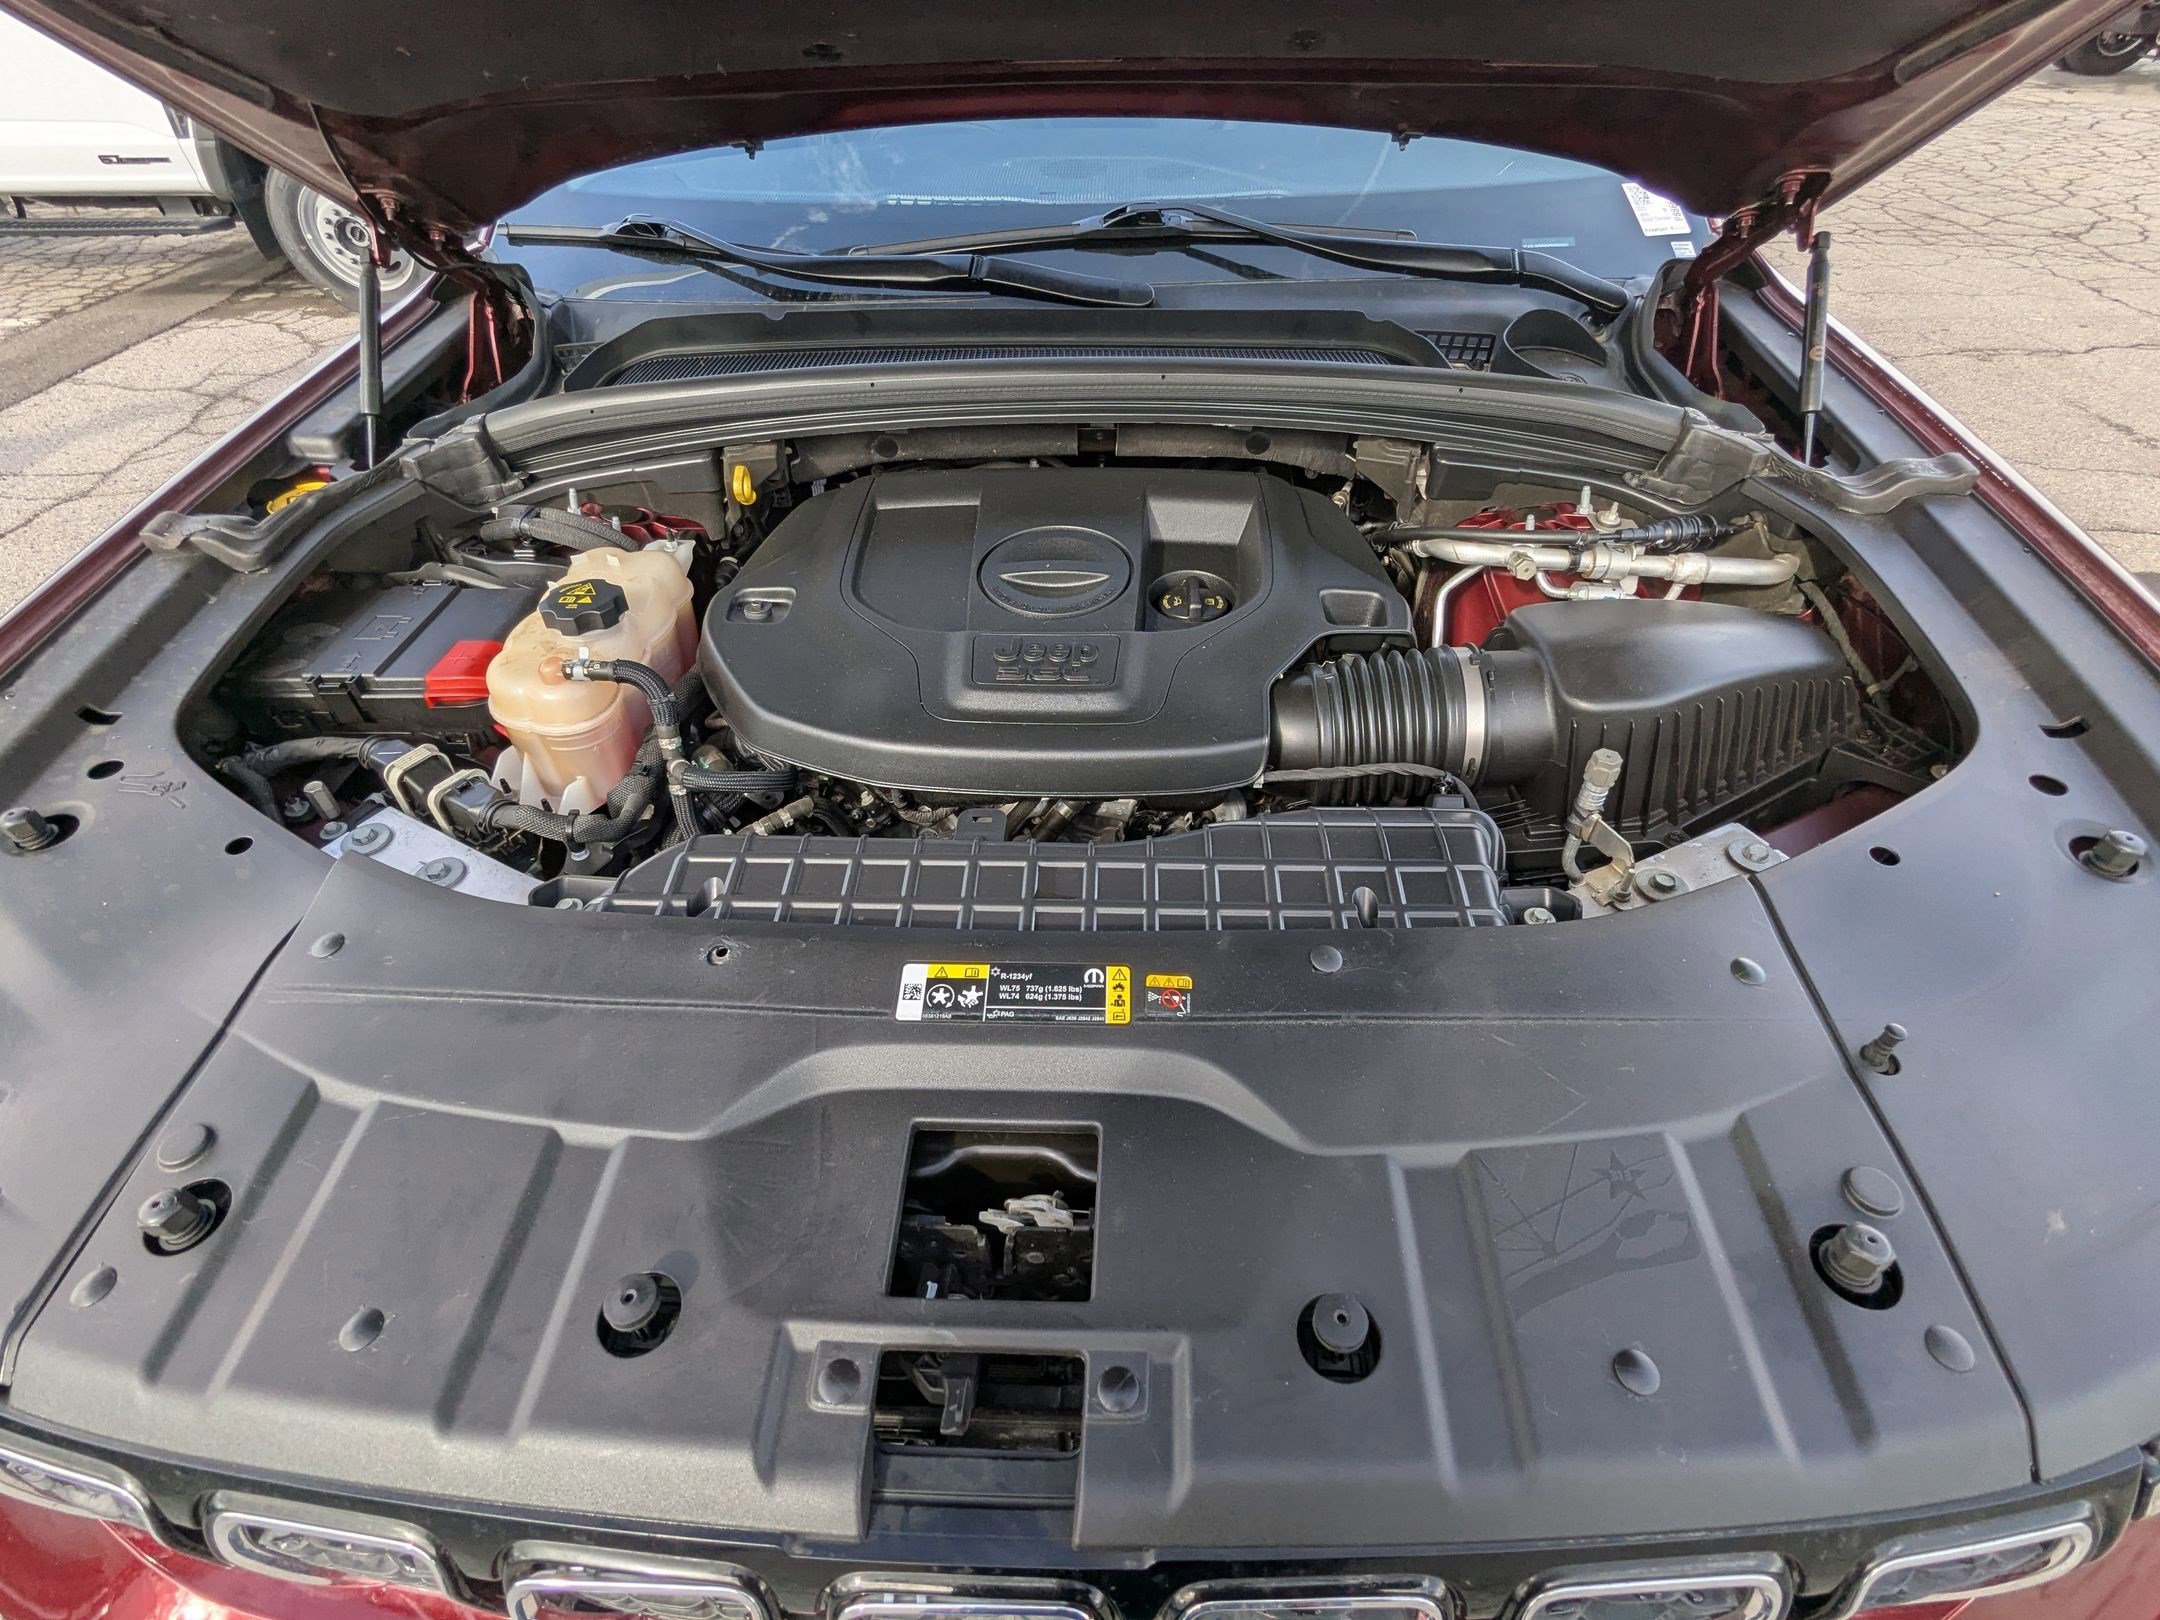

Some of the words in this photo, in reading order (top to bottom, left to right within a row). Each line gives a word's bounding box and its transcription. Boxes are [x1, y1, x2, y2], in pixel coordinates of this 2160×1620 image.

[993, 637, 1100, 667] Jeep
[1000, 973, 1033, 982] R-1234yf
[999, 985, 1021, 993] WL75
[1025, 985, 1044, 994] 737g
[1044, 985, 1068, 994] (1.625
[1068, 985, 1083, 995] lbs)
[998, 992, 1020, 1000] WL74
[1025, 993, 1043, 1002] 624g
[1044, 993, 1067, 1002] (1.375
[1067, 993, 1083, 1002] lbs)
